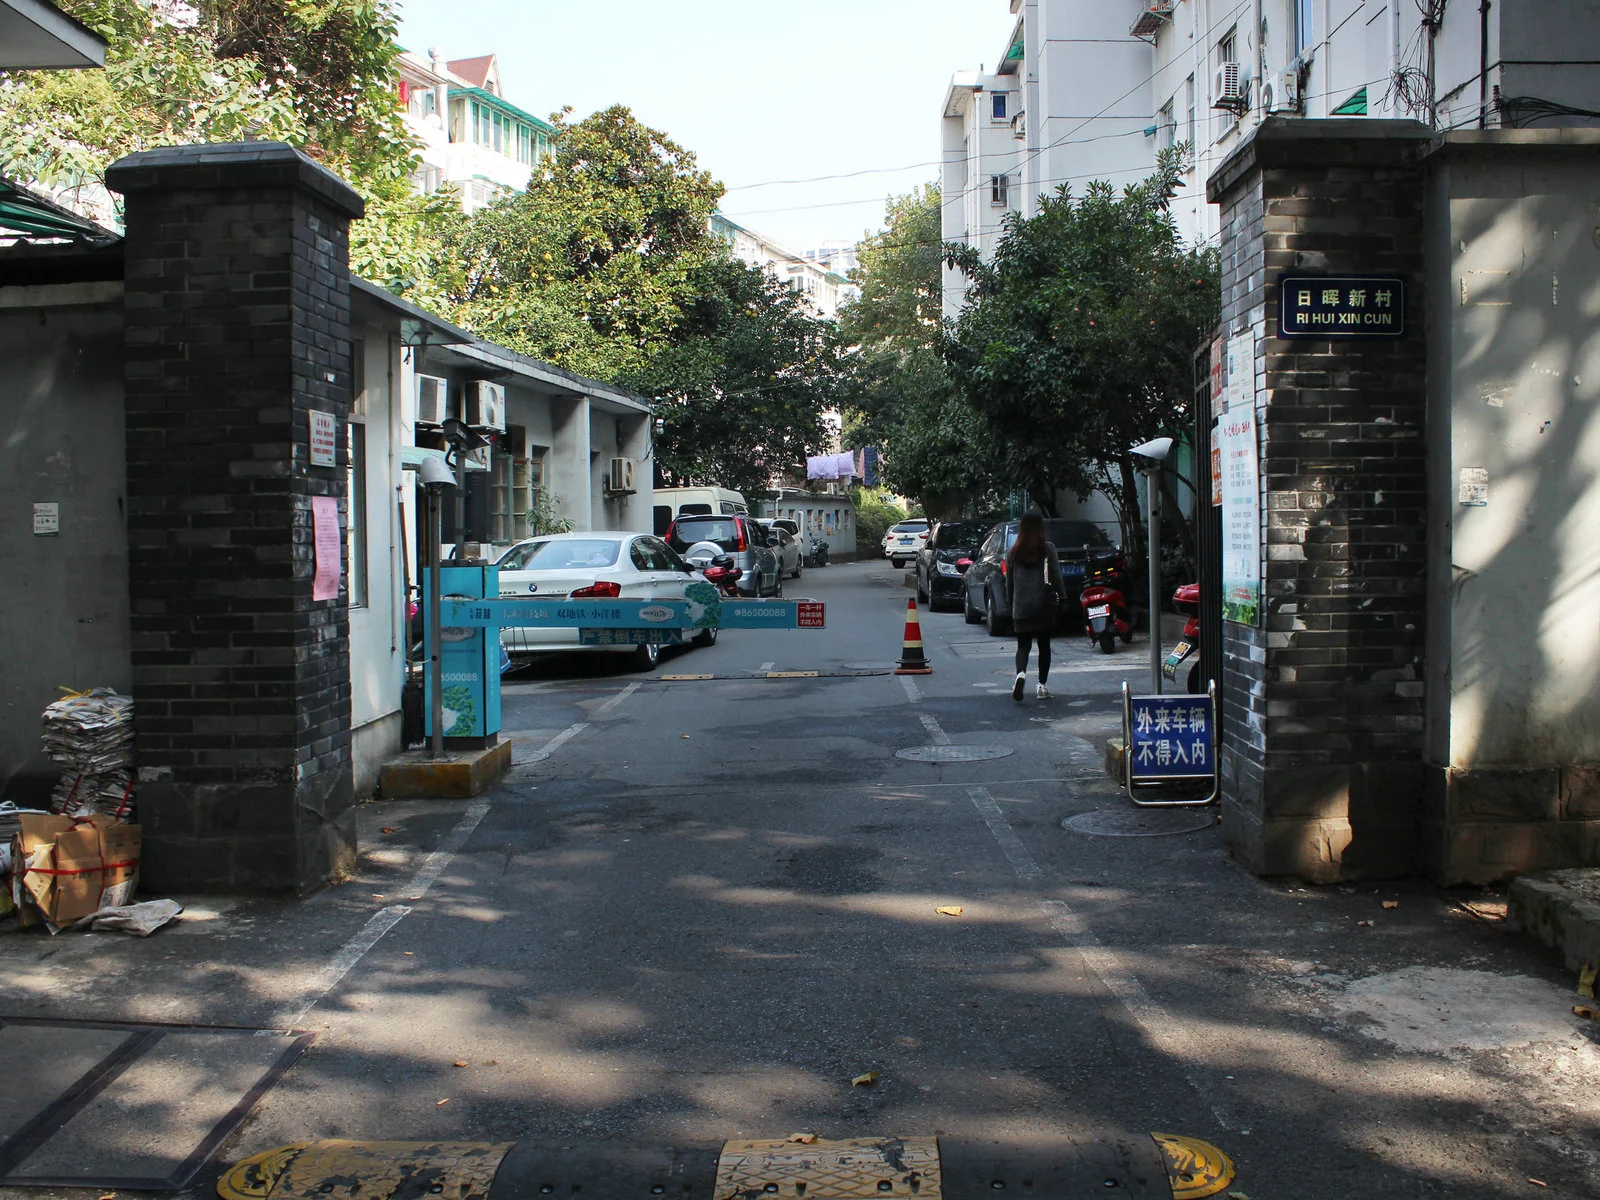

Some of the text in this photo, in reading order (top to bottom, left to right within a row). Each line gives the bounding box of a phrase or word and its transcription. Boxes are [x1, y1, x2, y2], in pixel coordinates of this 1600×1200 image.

[1297, 289, 1393, 308] 日晖新村
[1296, 313, 1392, 325] RI HUI XIN CUN
[580, 628, 681, 645] 严禁倒车出入
[1137, 706, 1206, 734] 外来车辆
[1137, 738, 1206, 767] 不得入内
